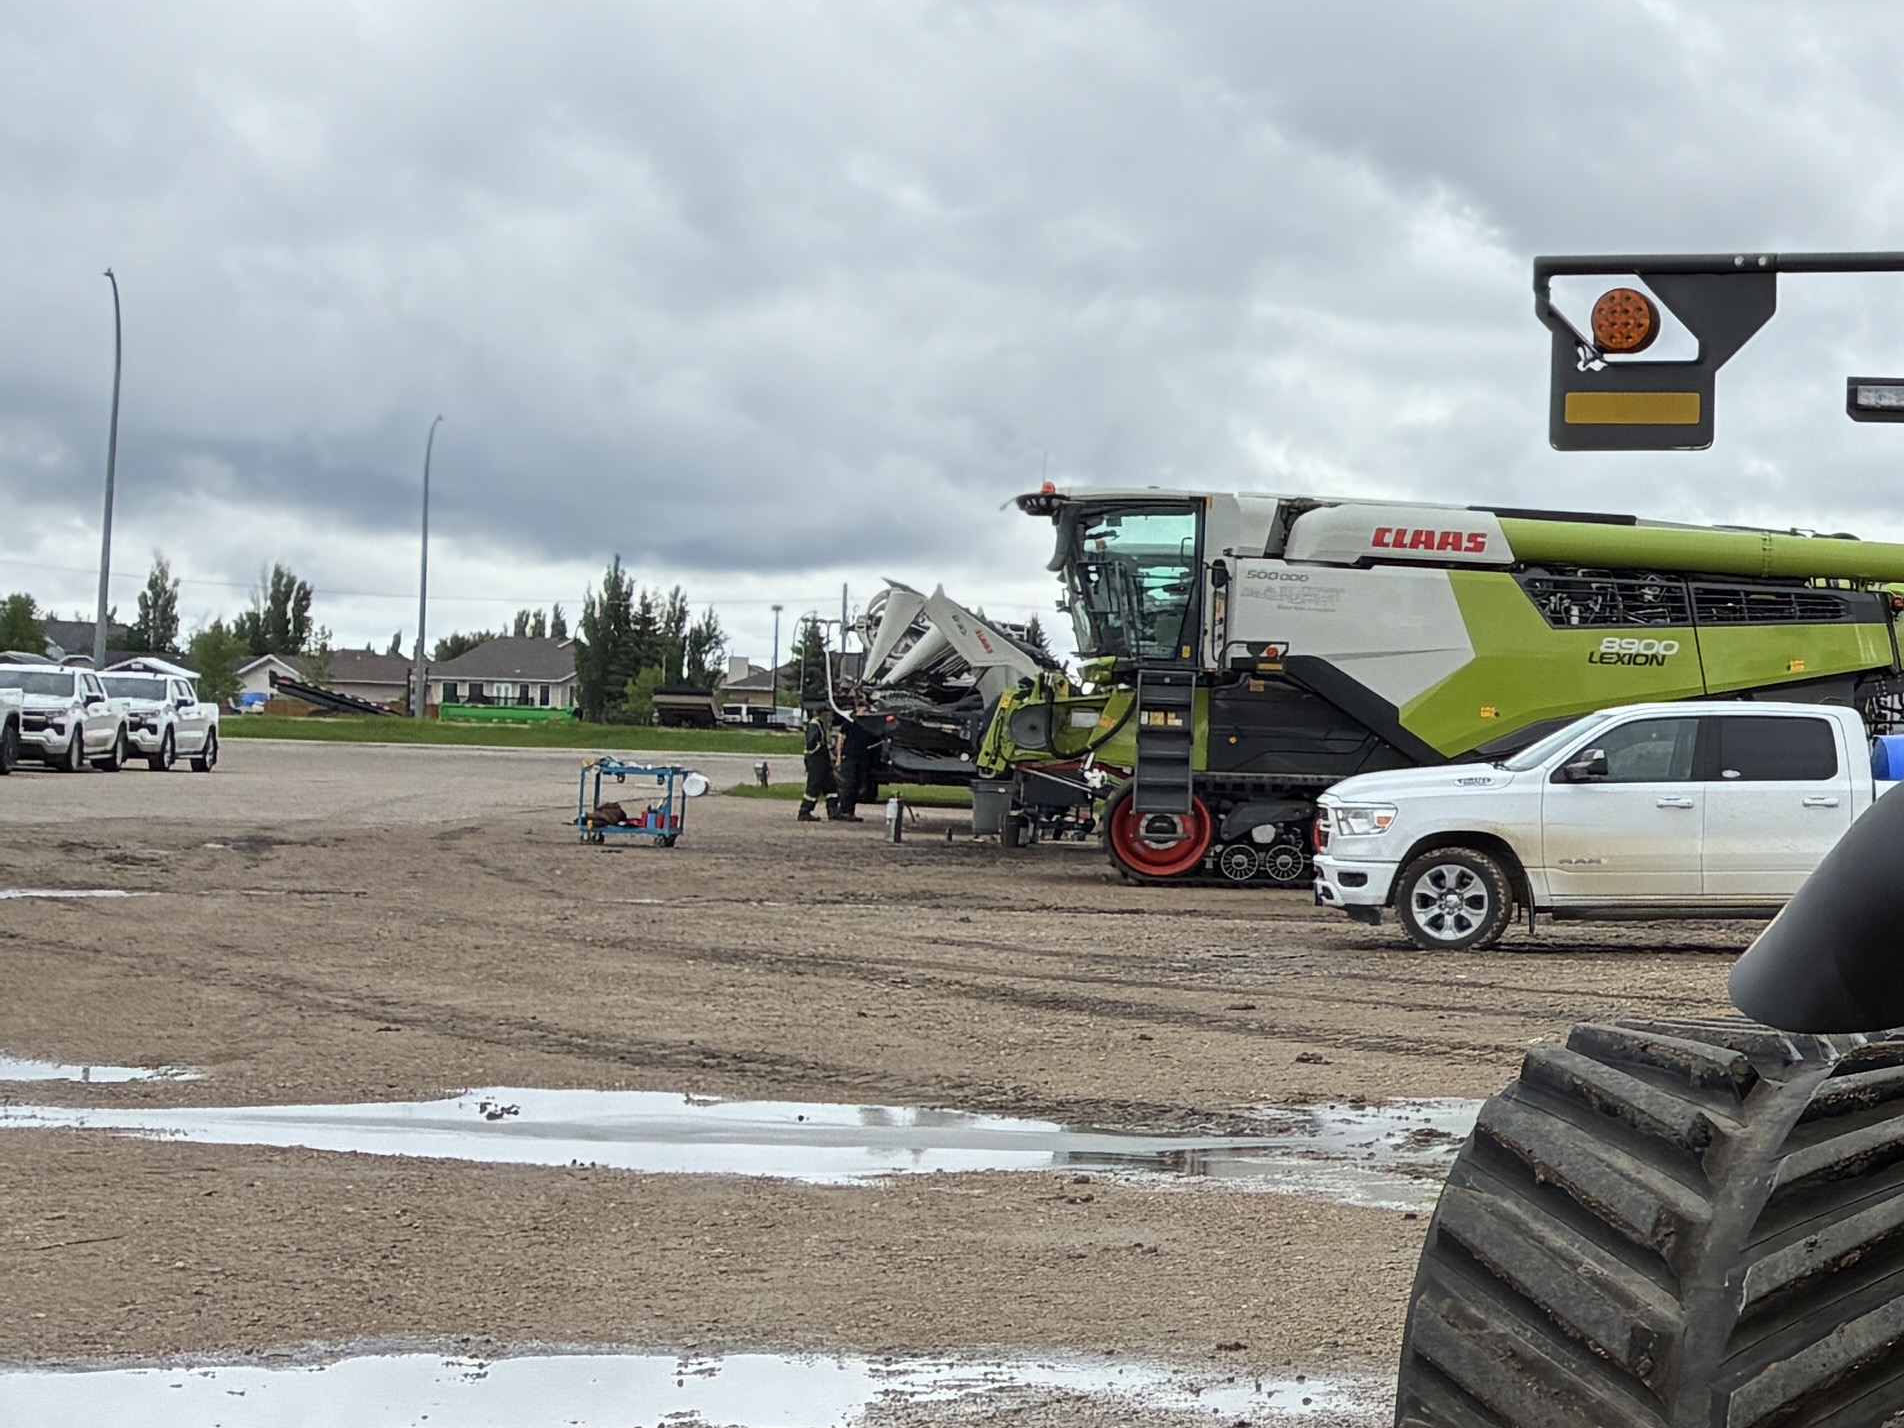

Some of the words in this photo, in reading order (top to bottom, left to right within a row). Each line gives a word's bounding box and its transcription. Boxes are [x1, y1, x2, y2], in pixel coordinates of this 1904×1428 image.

[1371, 527, 1488, 553] CLAAS
[1599, 637, 1680, 656] 8900
[1587, 650, 1667, 667] LEXION
